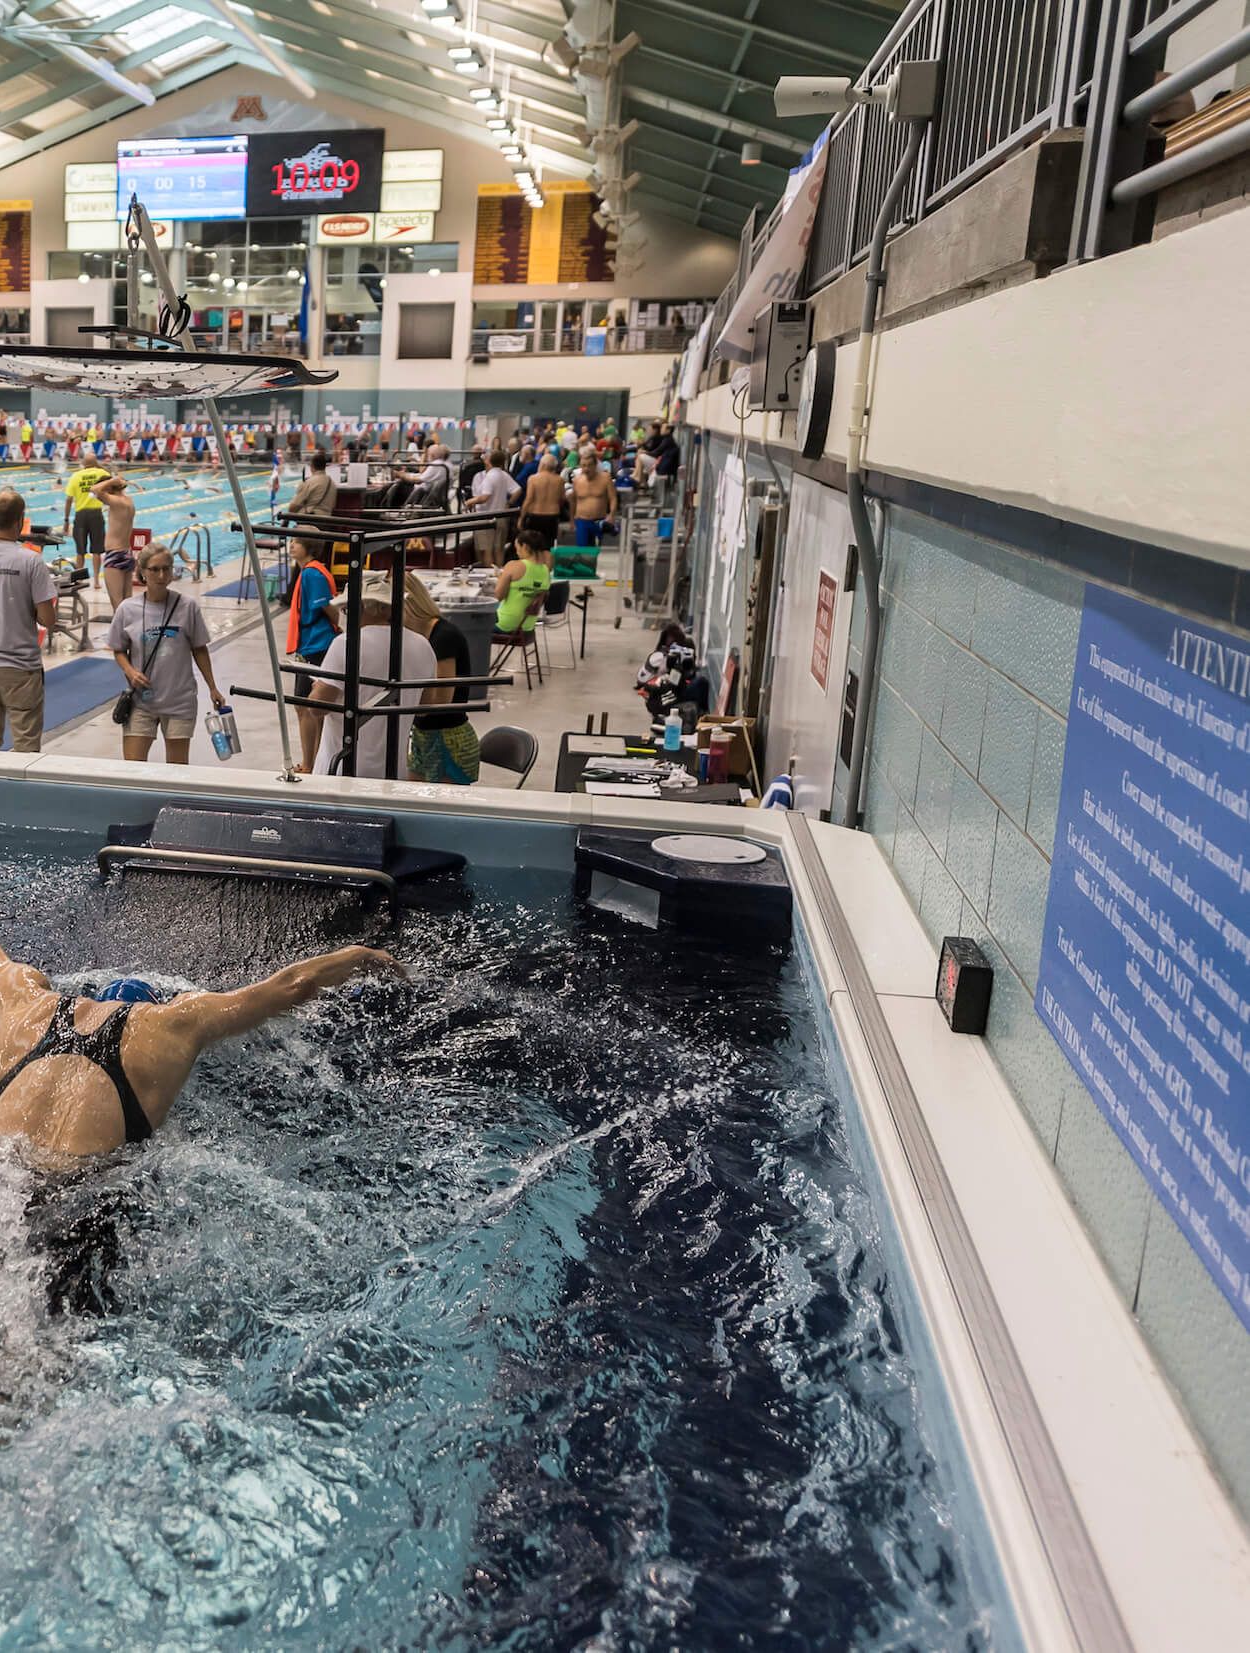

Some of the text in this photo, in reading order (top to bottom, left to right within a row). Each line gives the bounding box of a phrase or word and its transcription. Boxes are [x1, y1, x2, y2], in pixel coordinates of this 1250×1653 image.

[189, 174, 207, 189] 15
[270, 159, 360, 195] 10:09
[134, 535, 146, 547] NO
